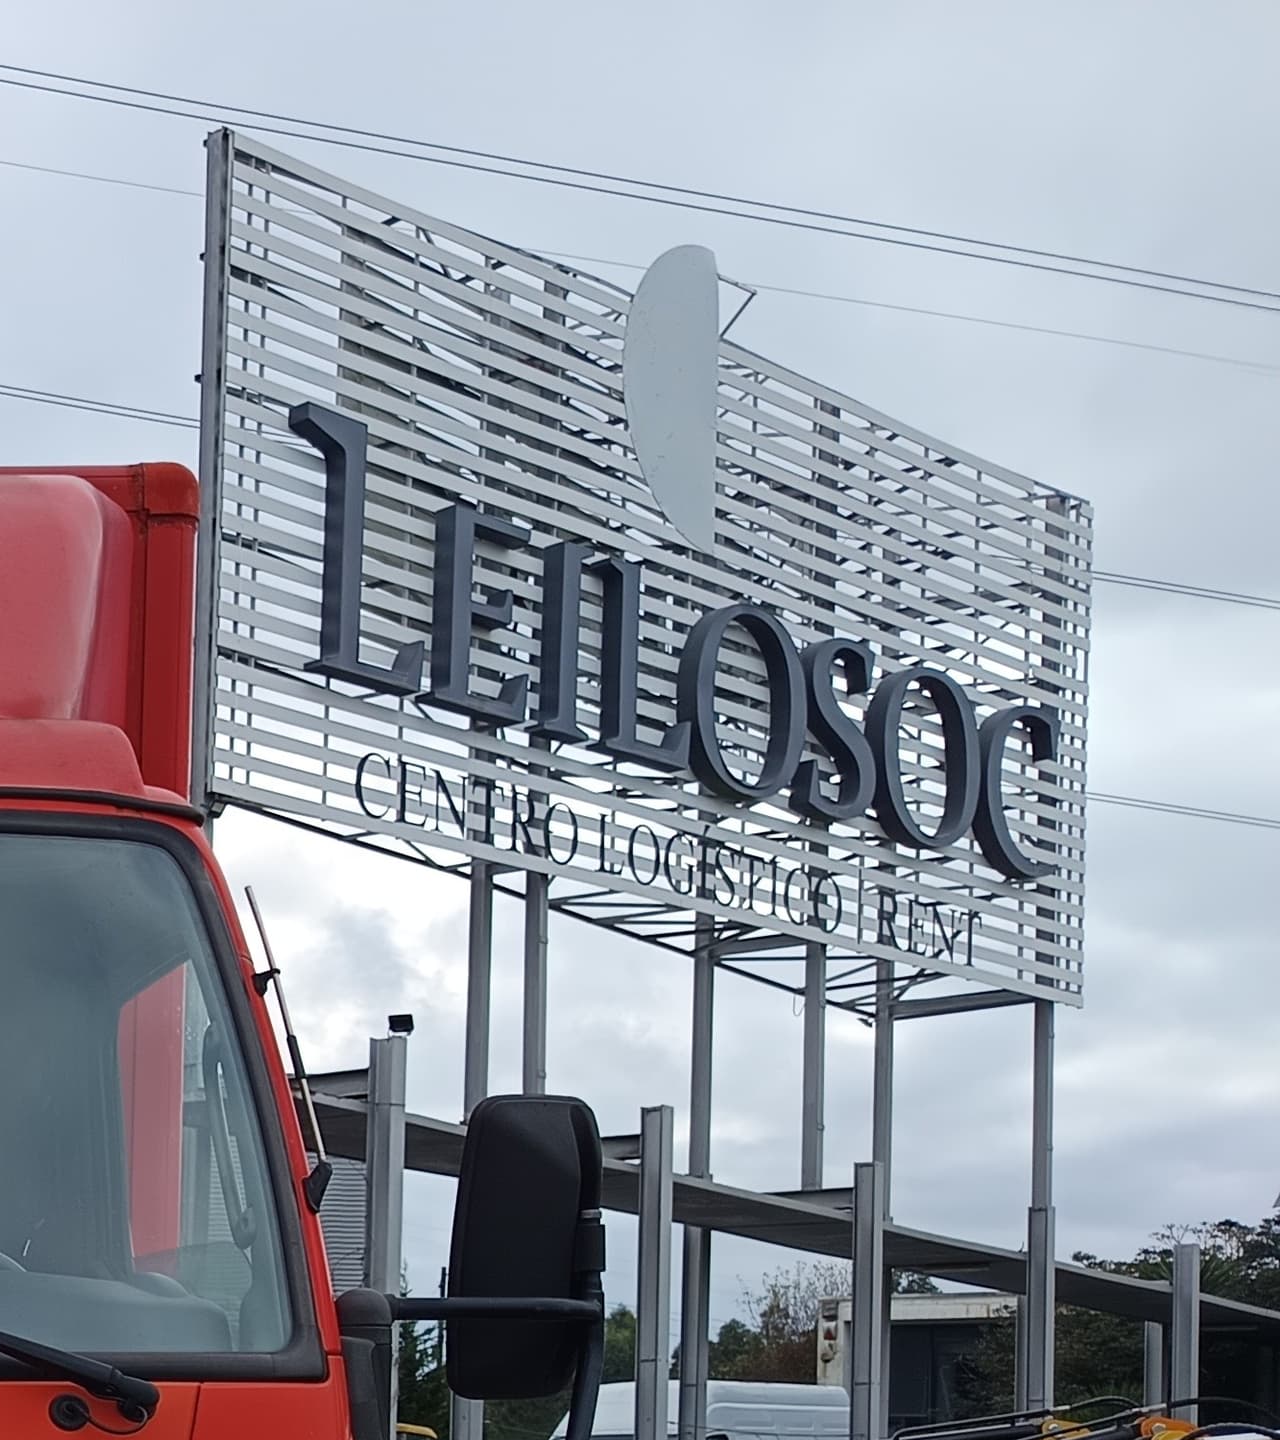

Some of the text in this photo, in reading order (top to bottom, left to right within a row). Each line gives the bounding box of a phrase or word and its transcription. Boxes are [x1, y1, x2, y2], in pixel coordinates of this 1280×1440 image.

[288, 402, 1061, 880] LEILOSOC
[355, 752, 578, 865] CENTRO
[876, 886, 983, 967] RENT
